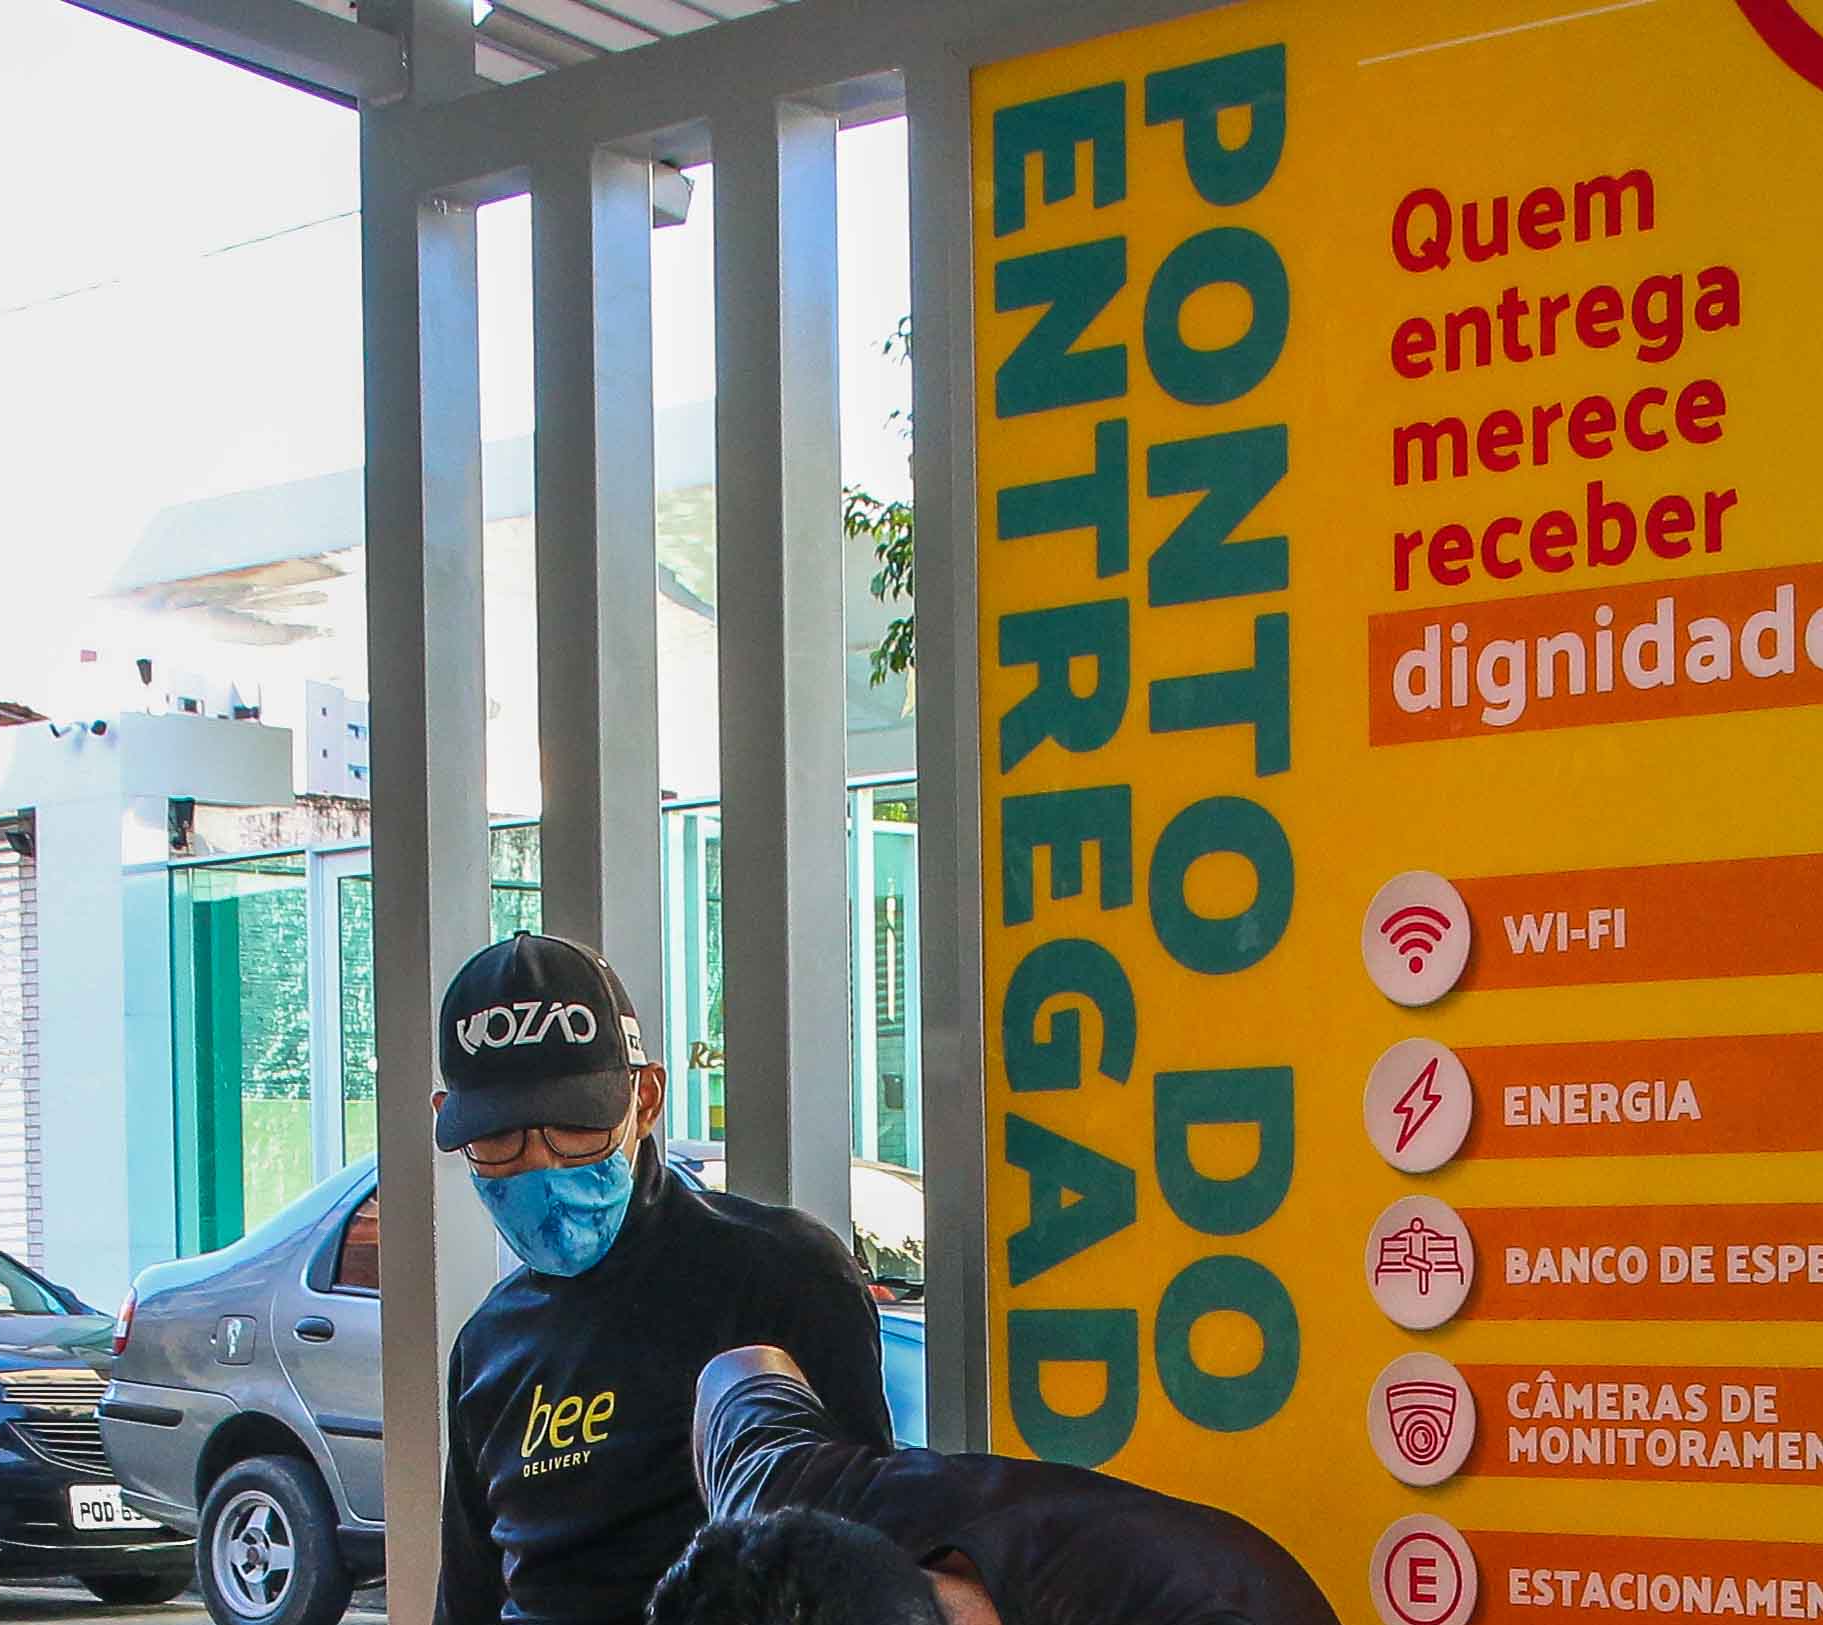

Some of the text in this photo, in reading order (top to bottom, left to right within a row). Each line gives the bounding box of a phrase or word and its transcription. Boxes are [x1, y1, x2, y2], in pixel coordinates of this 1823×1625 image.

[1391, 168, 1656, 273] Quem
[1390, 264, 1742, 379] entrega
[1392, 378, 1727, 486] merece
[1393, 481, 1739, 591] receber
[994, 81, 1139, 1468] ENTREGAD
[1144, 43, 1300, 1432] PONTO DO
[1503, 908, 1626, 954] WI-FI
[1504, 1079, 1702, 1127] ENERGIA
[1506, 1245, 1649, 1285] BANCO
[1660, 1245, 1716, 1284] DE
[521, 1384, 615, 1458] bee
[1507, 1370, 1779, 1424] CÂMERAS DE
[523, 1450, 591, 1478] DELIVERY
[1409, 1557, 1437, 1604] E
